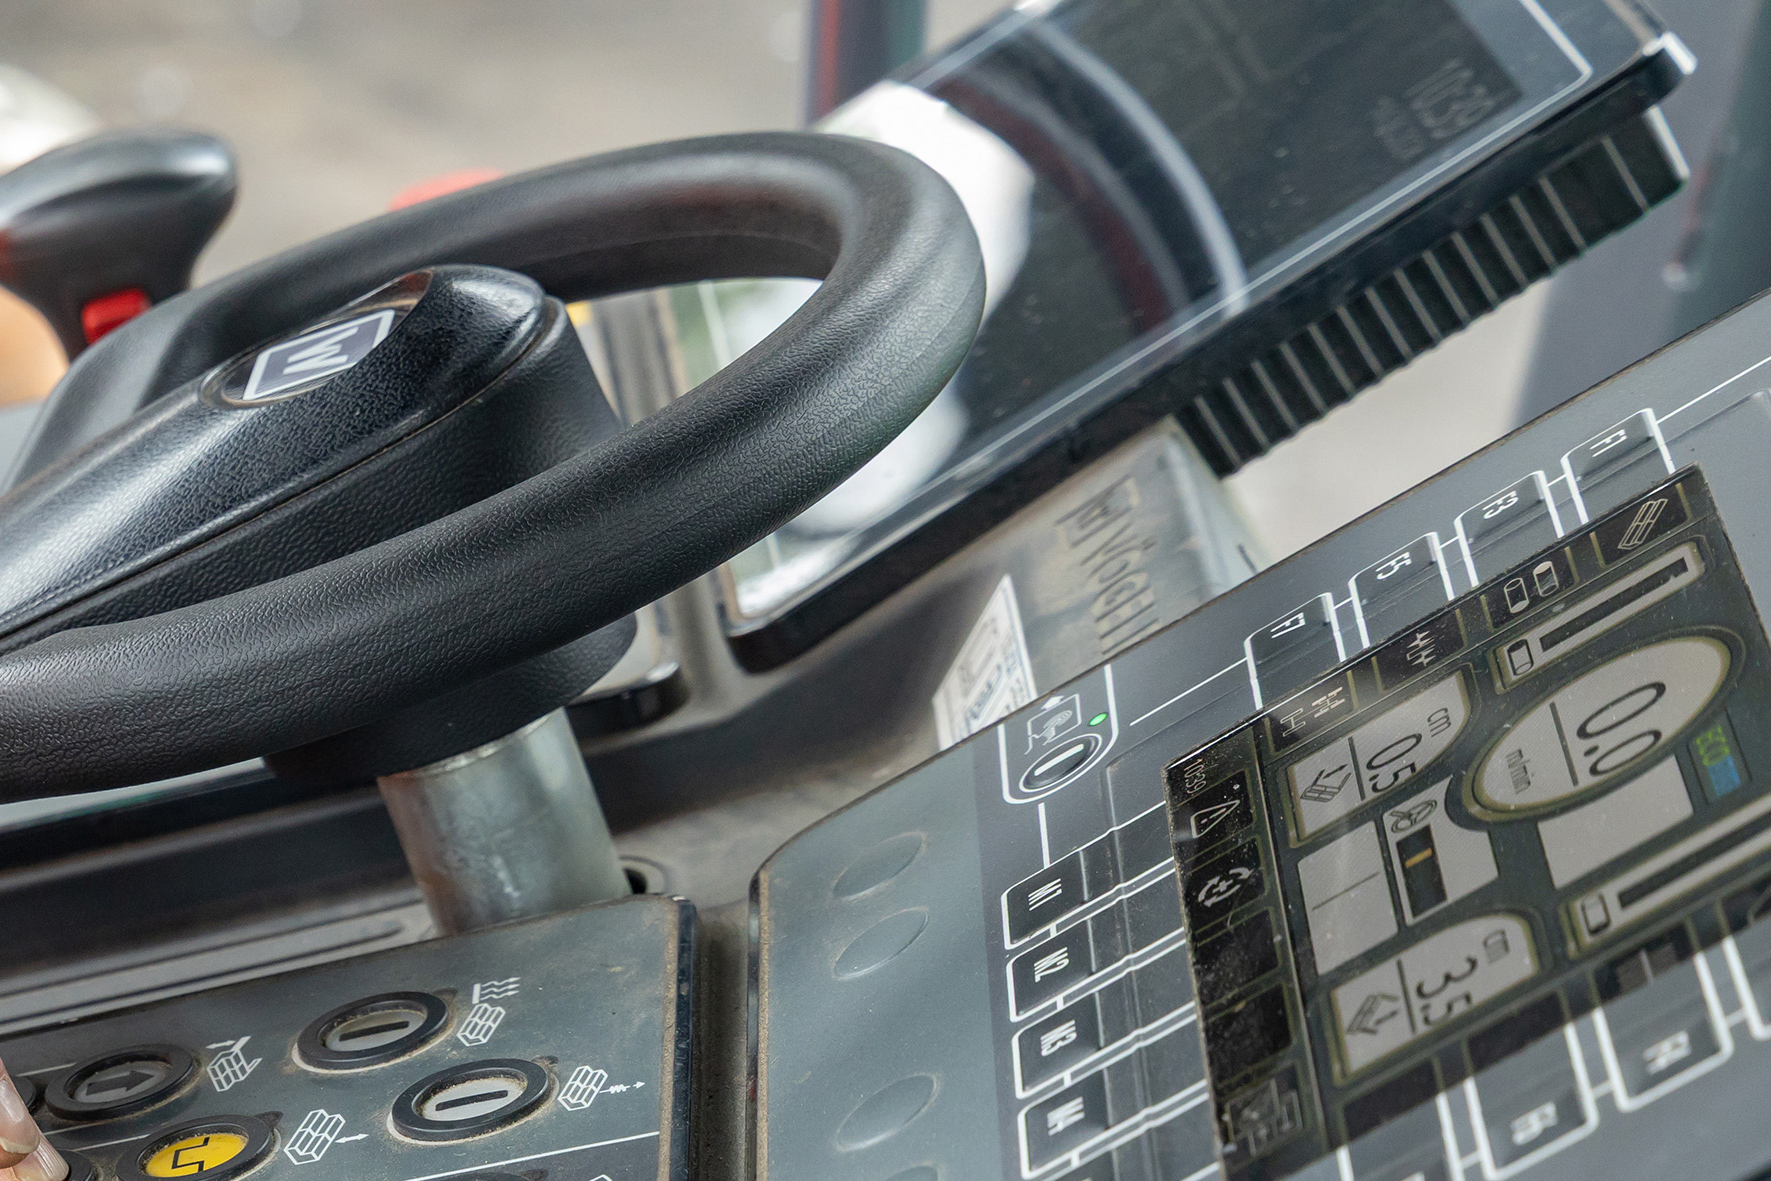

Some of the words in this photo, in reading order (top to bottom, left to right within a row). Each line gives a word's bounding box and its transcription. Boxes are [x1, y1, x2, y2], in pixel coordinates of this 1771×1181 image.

[1589, 429, 1627, 457] F1
[1482, 490, 1518, 519] F3
[1375, 552, 1412, 580] F5
[1271, 612, 1306, 639] F7
[1427, 707, 1452, 738] cm
[1576, 681, 1666, 777] 0.0
[1366, 733, 1422, 793] 0.5
[1505, 749, 1532, 795] m/min
[1028, 878, 1062, 911] M1
[1034, 947, 1069, 983] M2
[1416, 956, 1478, 1028] 3.5
[1040, 1019, 1077, 1056] M3
[1047, 1096, 1085, 1136] M4
